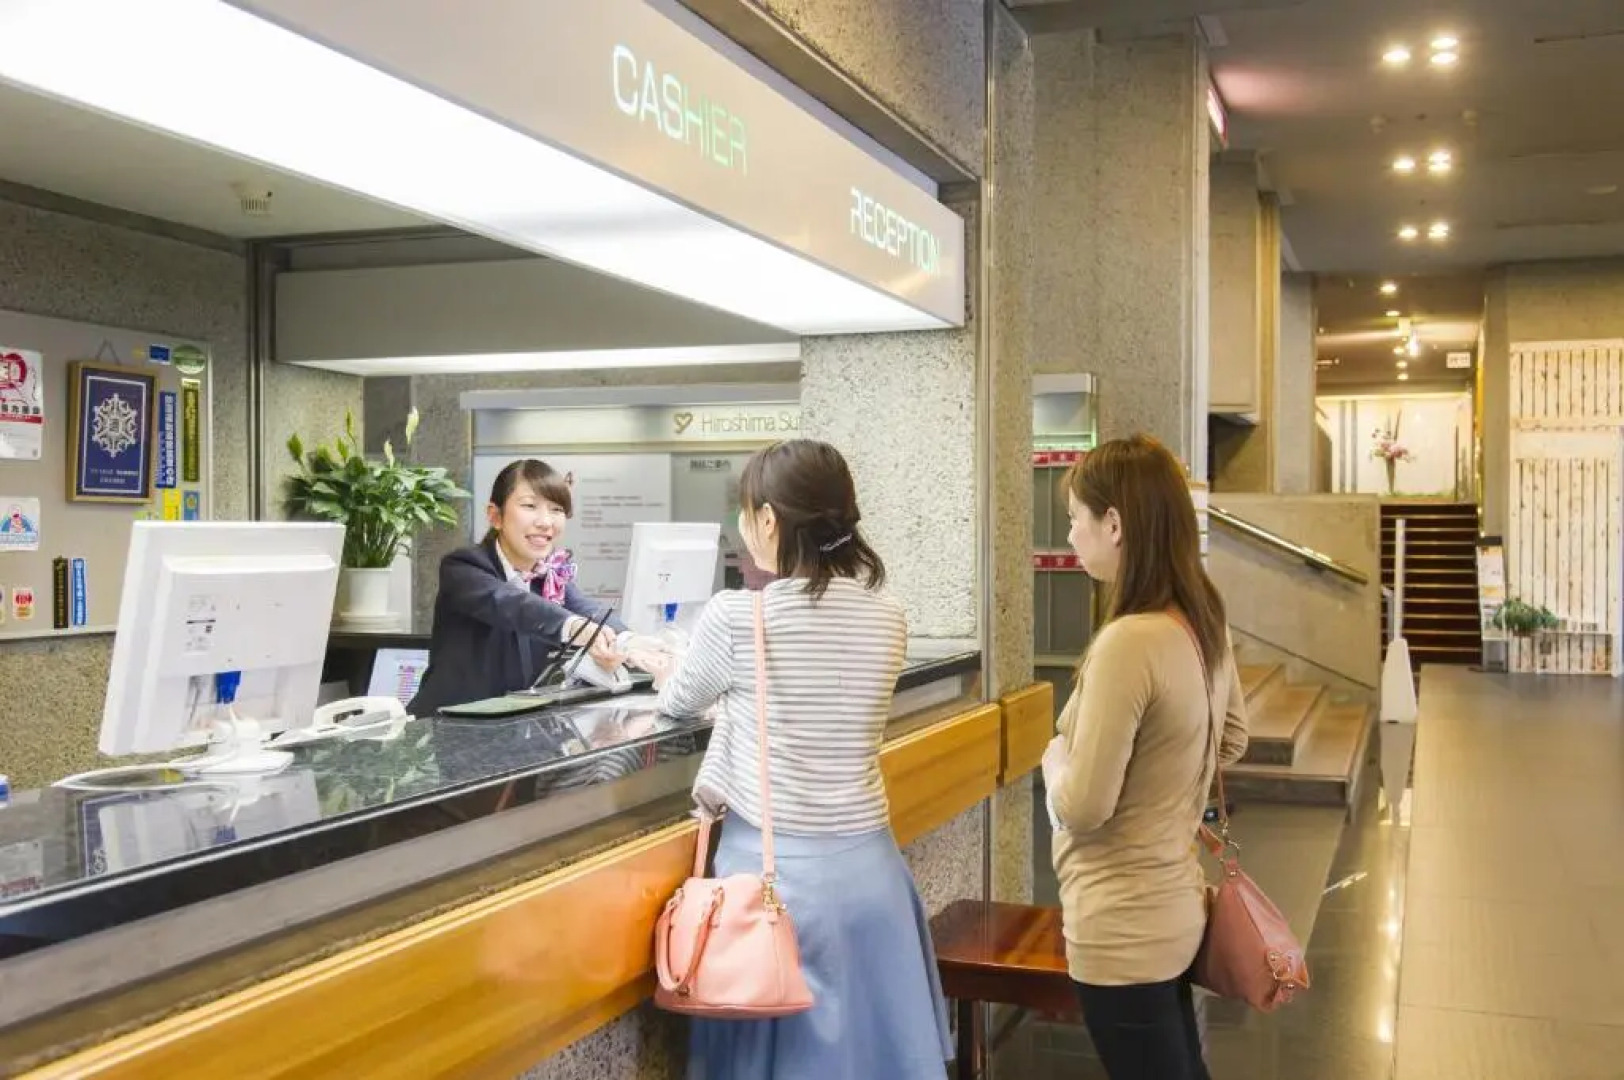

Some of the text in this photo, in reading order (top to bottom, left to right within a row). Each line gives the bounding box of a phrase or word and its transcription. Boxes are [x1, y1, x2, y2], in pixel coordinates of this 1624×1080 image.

[612, 44, 748, 176] CASHIER
[850, 187, 941, 277] RECEPTION
[702, 410, 775, 433] Hiroshima
